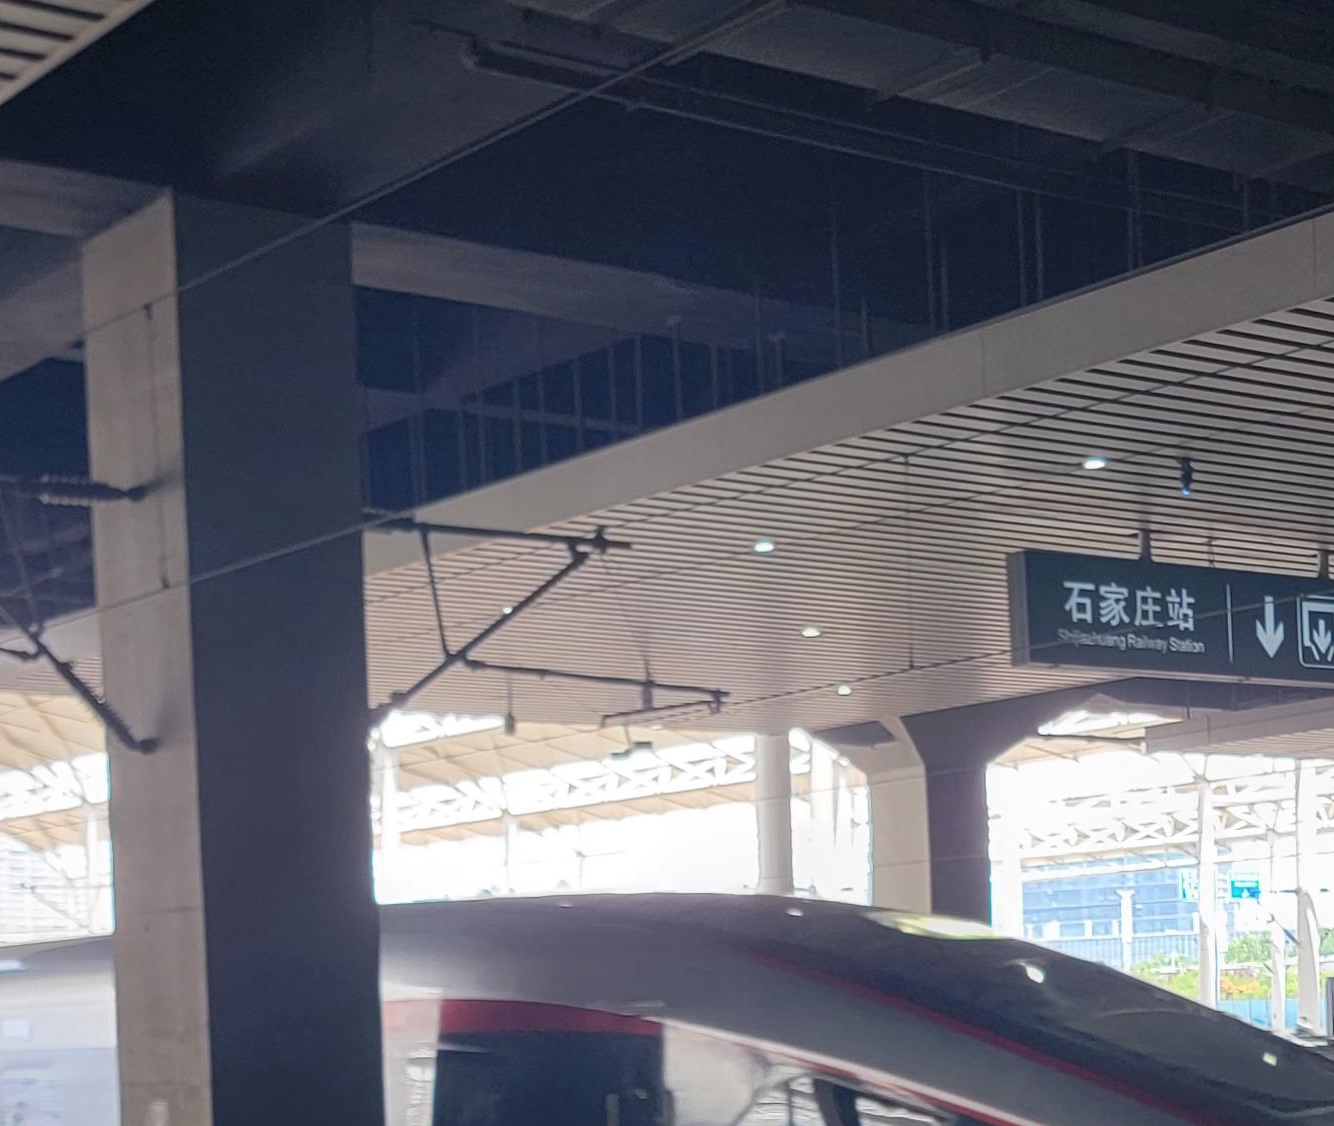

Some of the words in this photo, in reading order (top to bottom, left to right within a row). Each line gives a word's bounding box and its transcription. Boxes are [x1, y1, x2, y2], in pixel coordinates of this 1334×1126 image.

[1063, 581, 1196, 632] 石家庄站
[1127, 633, 1168, 654] Railway
[1168, 636, 1206, 654] Station
